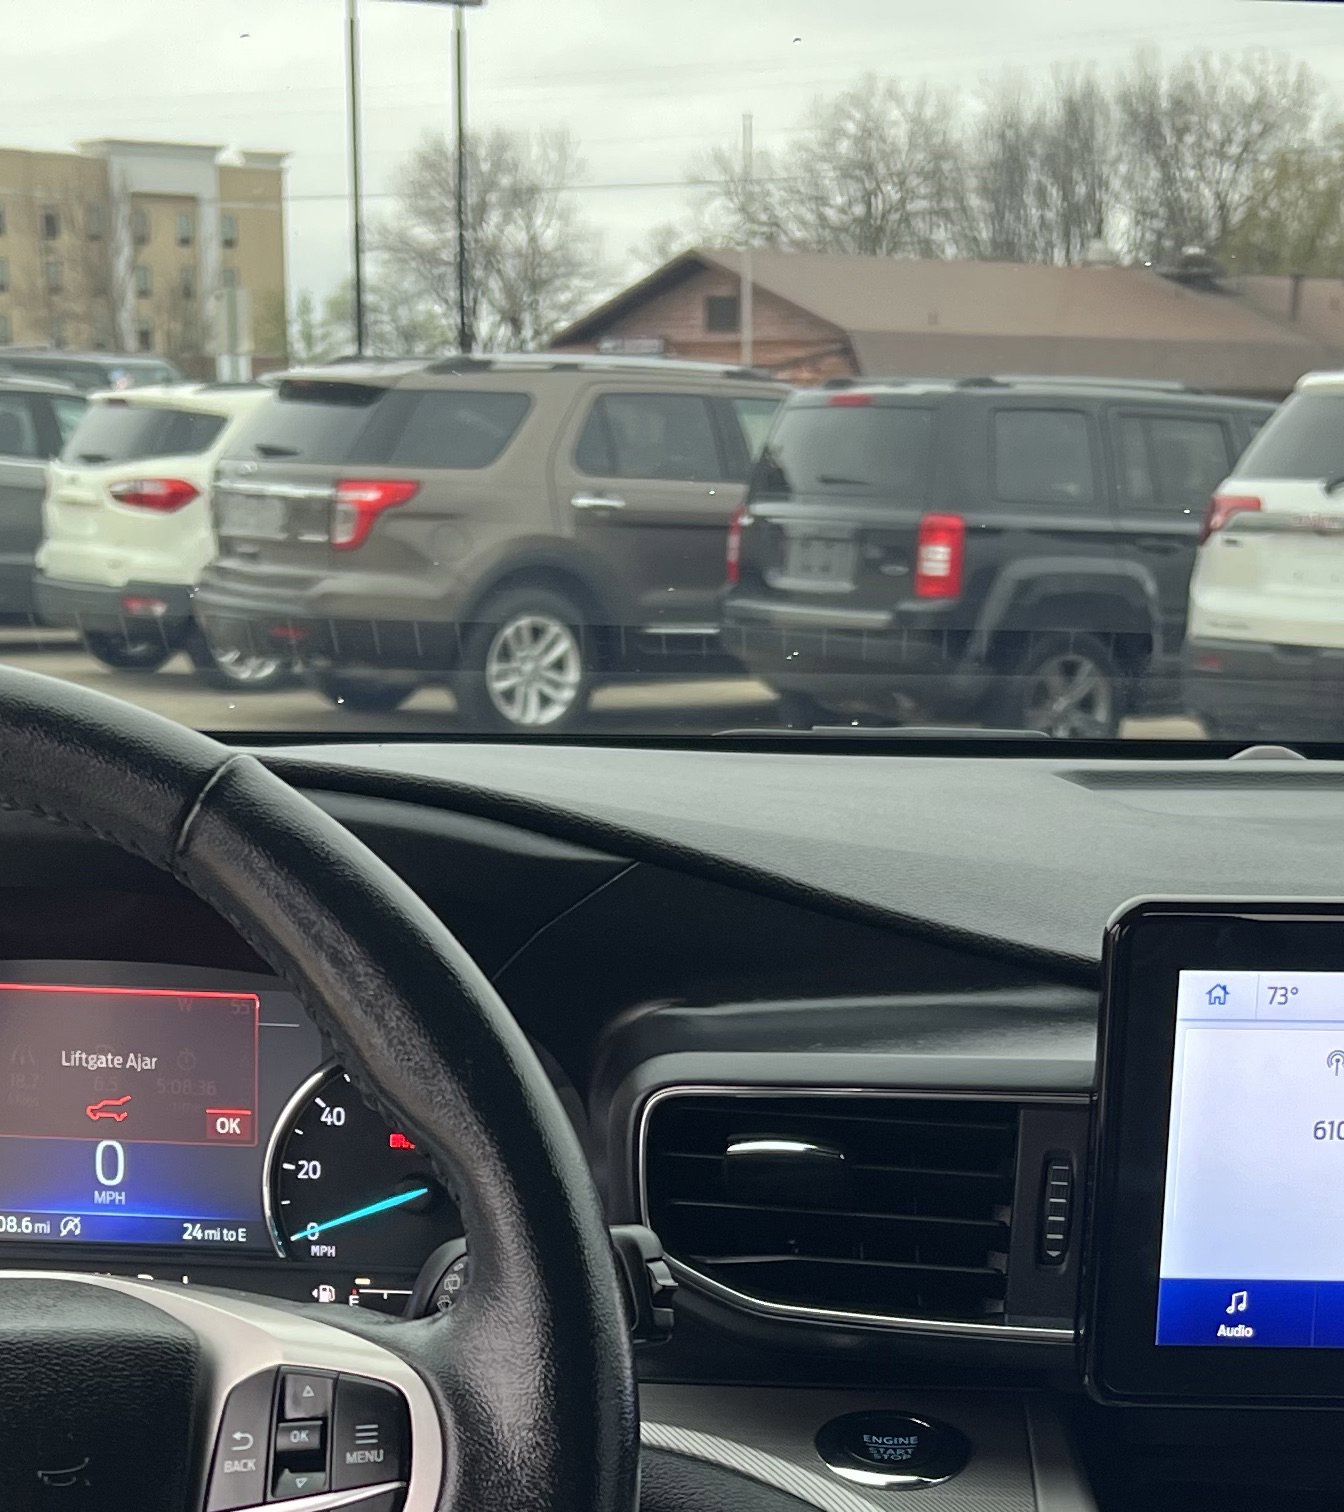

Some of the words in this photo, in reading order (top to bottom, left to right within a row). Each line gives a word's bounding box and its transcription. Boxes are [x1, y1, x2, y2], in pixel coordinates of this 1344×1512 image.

[1267, 986, 1299, 1005] 73°
[61, 1050, 124, 1071] Liftgate
[125, 1052, 159, 1072] Ajar
[320, 1107, 346, 1126] 40
[215, 1117, 241, 1135] OK
[94, 1139, 125, 1187] 0
[297, 1160, 322, 1180] 20
[94, 1191, 126, 1206] MPH
[34, 1221, 51, 1234] mi
[182, 1223, 203, 1240] 24
[204, 1227, 221, 1241] mi
[222, 1228, 236, 1242] to
[238, 1229, 247, 1242] E
[306, 1222, 320, 1241] 0
[310, 1245, 336, 1258] MPH
[1217, 1324, 1254, 1338] Audio
[290, 1430, 310, 1443] OK
[862, 1434, 919, 1445] ENGINE
[223, 1458, 256, 1473] BACK
[345, 1449, 384, 1465] MENU
